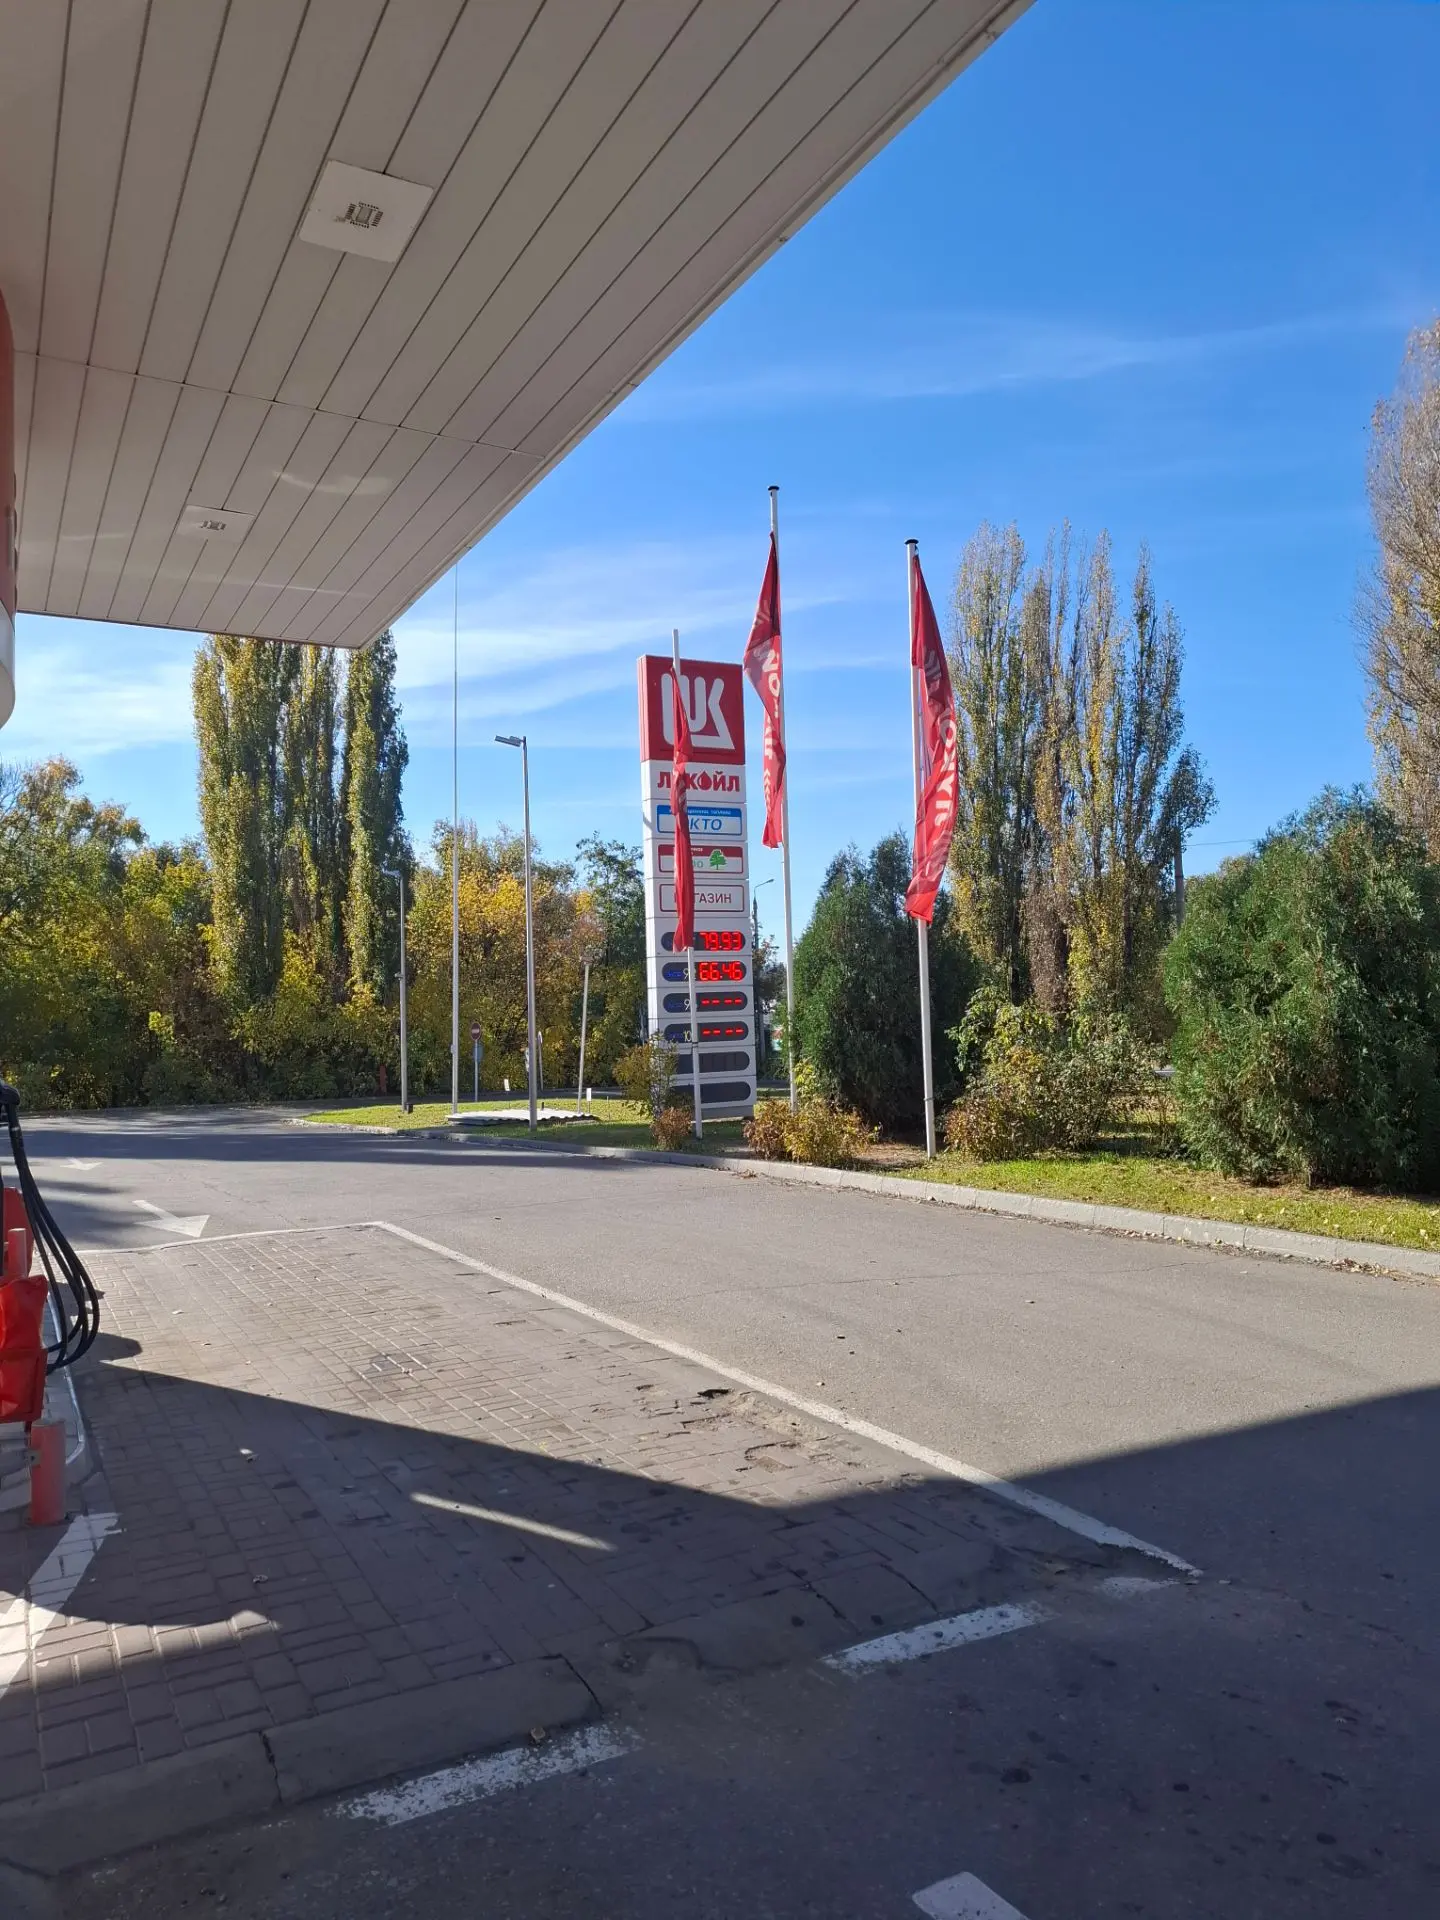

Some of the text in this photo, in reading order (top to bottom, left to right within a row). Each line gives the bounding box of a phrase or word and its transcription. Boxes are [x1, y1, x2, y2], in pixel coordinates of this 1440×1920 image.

[657, 770, 740, 792] ЛКОЙЛ
[689, 818, 722, 831] КТО
[675, 892, 732, 904] ГАЗИН
[700, 932, 742, 951] 79.93
[699, 961, 743, 981] 66.46
